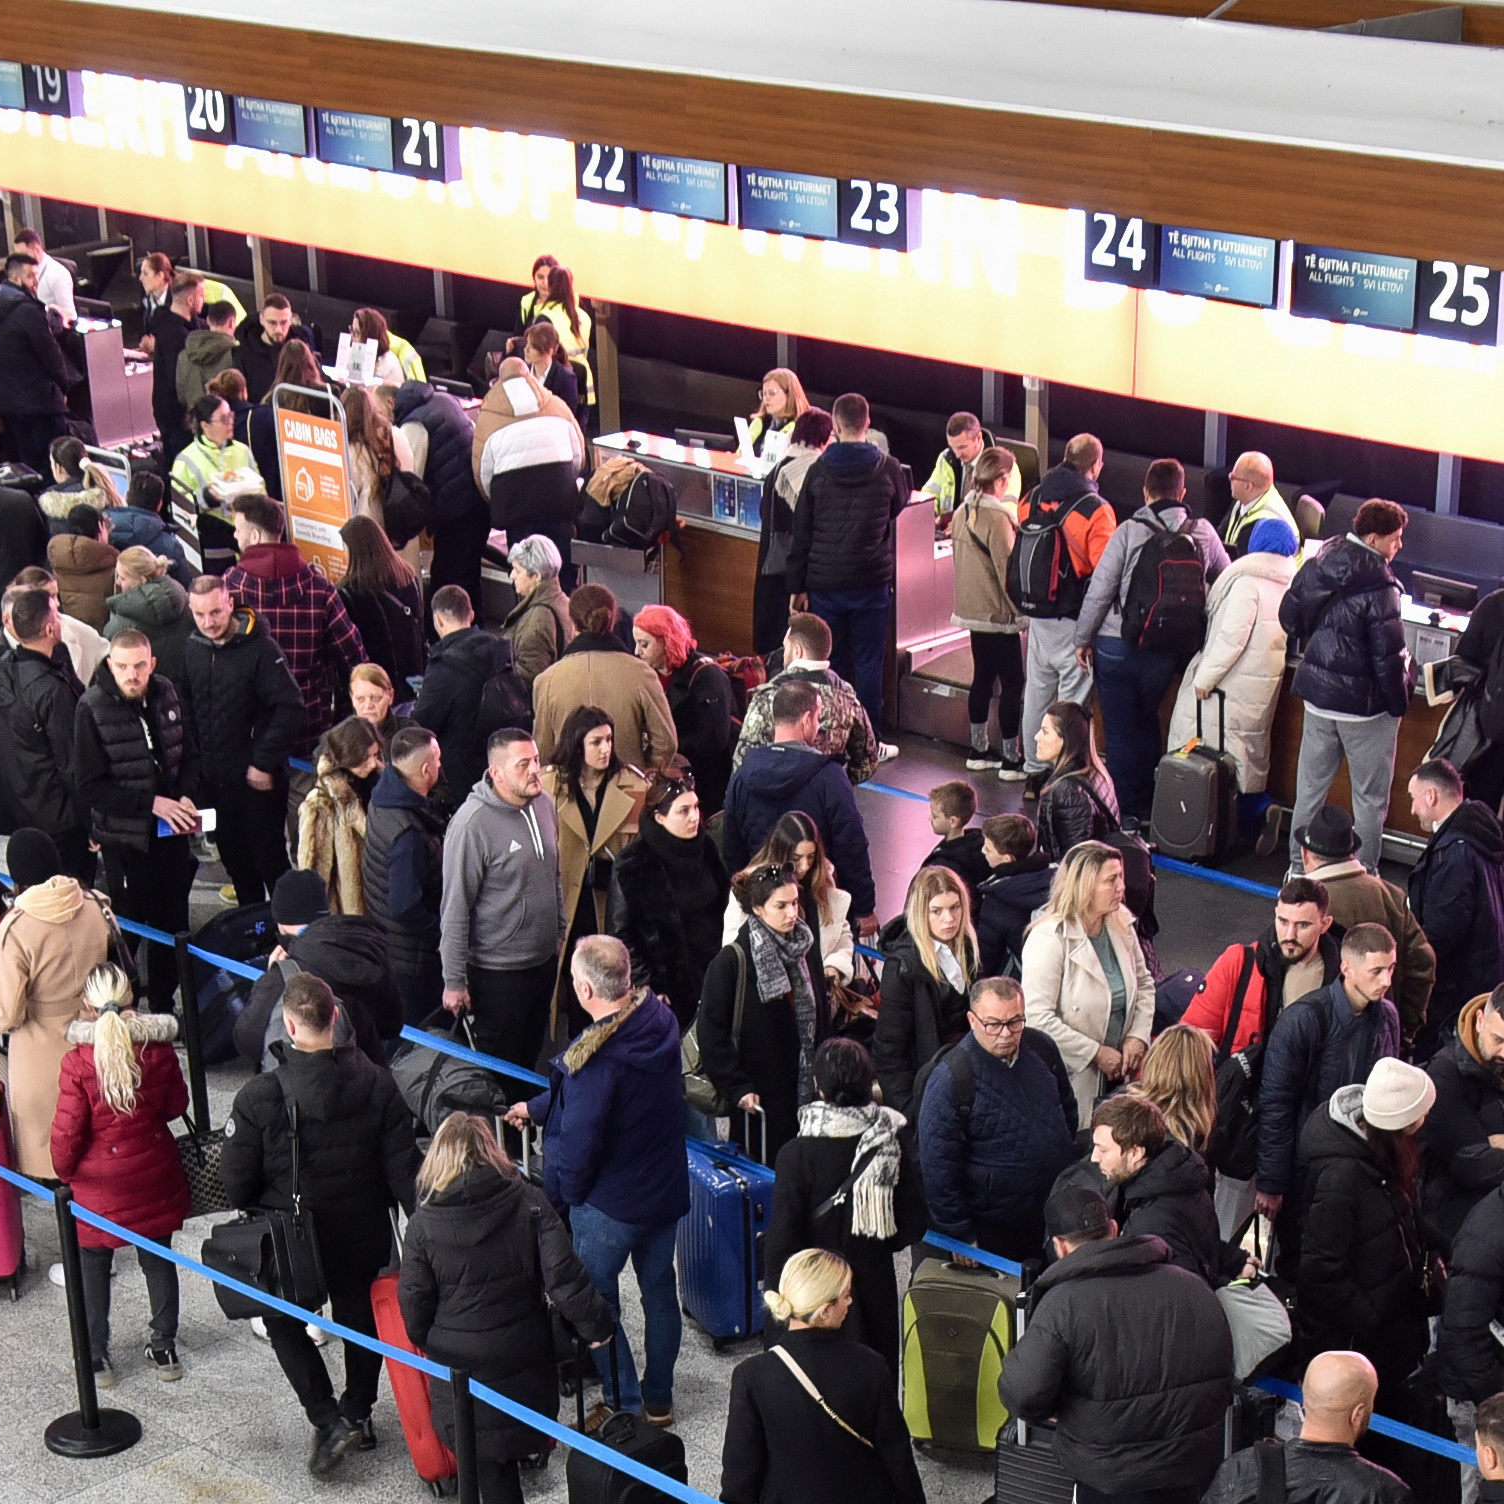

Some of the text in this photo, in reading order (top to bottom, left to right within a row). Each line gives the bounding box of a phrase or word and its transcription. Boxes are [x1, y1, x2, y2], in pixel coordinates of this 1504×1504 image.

[32, 65, 62, 103] 19
[187, 86, 225, 133] 20
[402, 118, 438, 168] 21
[582, 143, 625, 193] 22
[641, 155, 650, 167] TË
[652, 157, 676, 171] GJITHA
[646, 170, 656, 179] ALL
[657, 171, 680, 184] FLIGHTS
[747, 173, 832, 195] TË GJITHA FLUTURIMET
[751, 189, 762, 198] ALL
[763, 190, 789, 201] FLIGHTS
[795, 194, 806, 204] SVI
[849, 180, 899, 235] 23
[1090, 213, 1146, 271] 24
[1168, 230, 1269, 257] TË GJITHA FLUTURIMET
[1172, 248, 1263, 271] ALL FLIGHTS SVI LETOVI
[1305, 254, 1410, 280] TË GJITHA FLUTURIMET
[1309, 271, 1404, 294] ALL FLIGHTS SVI LETOVI
[1428, 261, 1491, 327] 25
[284, 418, 338, 450] CABIN BAGS
